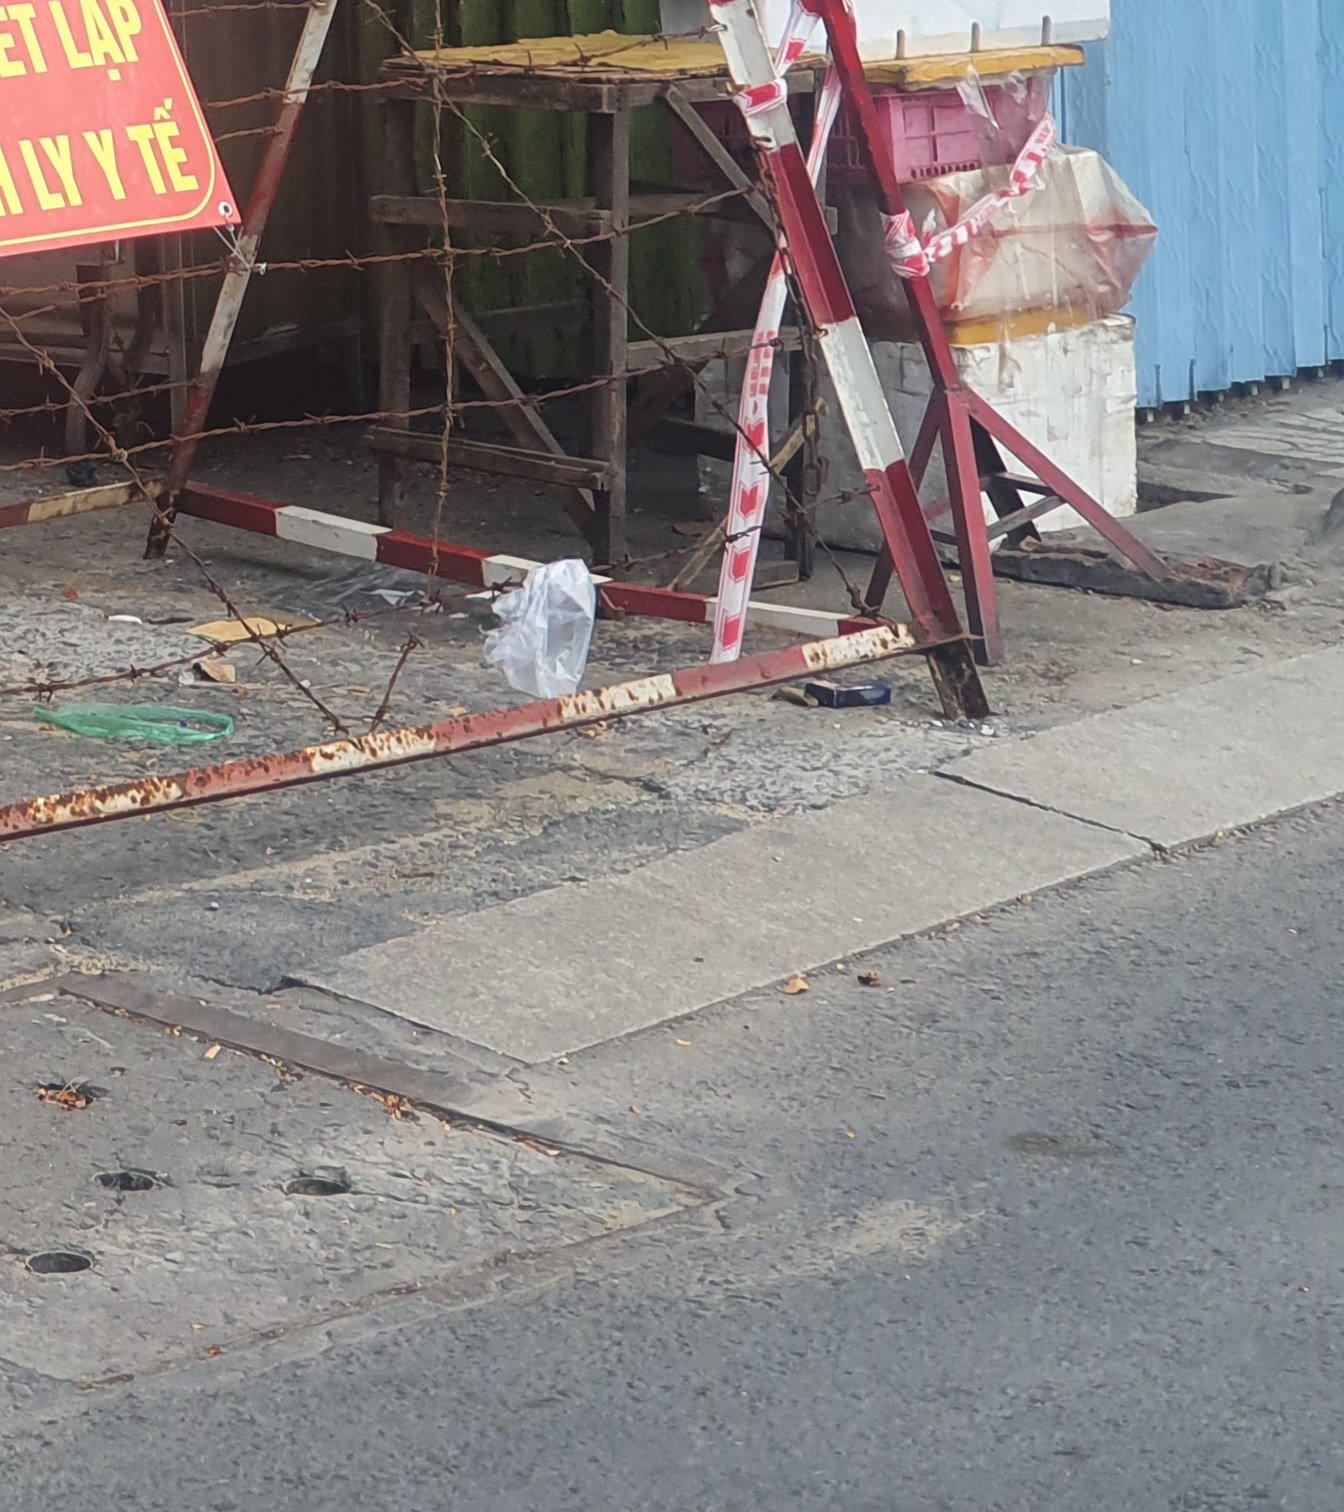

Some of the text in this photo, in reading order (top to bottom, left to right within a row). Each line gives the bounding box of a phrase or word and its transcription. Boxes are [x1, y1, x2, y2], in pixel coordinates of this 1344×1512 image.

[18, 134, 84, 212] LY
[82, 129, 127, 201] Y
[124, 98, 200, 196] TẾ
